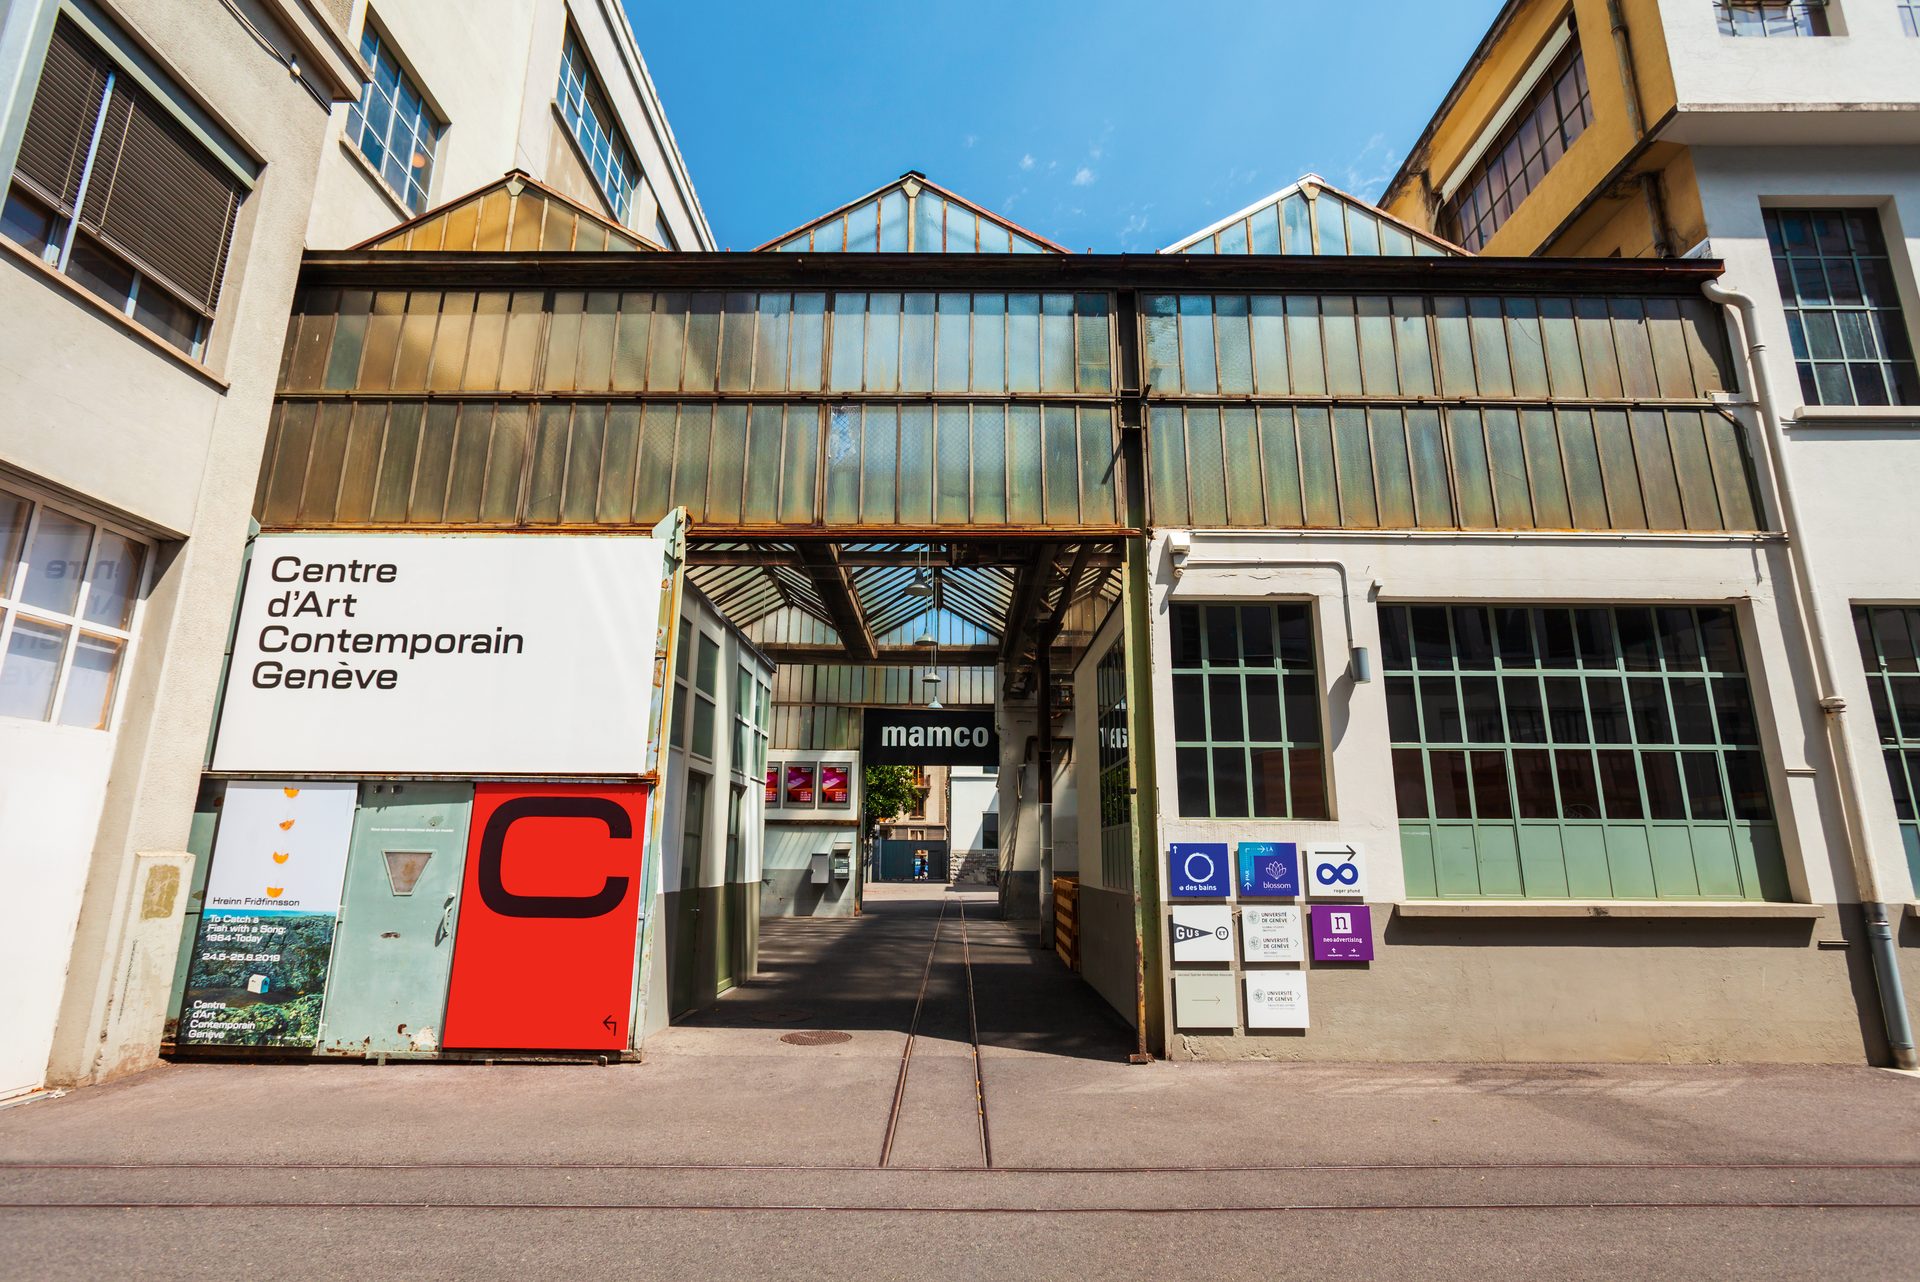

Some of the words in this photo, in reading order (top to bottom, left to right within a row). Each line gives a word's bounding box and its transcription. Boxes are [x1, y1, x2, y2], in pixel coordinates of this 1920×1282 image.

[271, 555, 398, 583] Centre
[267, 590, 357, 618] d’Art
[258, 625, 524, 660] Contemporain
[252, 660, 398, 690] Genève
[881, 725, 990, 748] mamco
[478, 796, 633, 919] C
[1263, 881, 1292, 889] blossom
[212, 896, 242, 905] Hreinn
[209, 914, 222, 923] To
[222, 914, 251, 924] Catch
[252, 916, 260, 924] a
[1334, 916, 1349, 930] n
[206, 923, 228, 932] Fish
[229, 923, 250, 933] with
[193, 1000, 226, 1009] Centre
[190, 1019, 256, 1030] Contemporain
